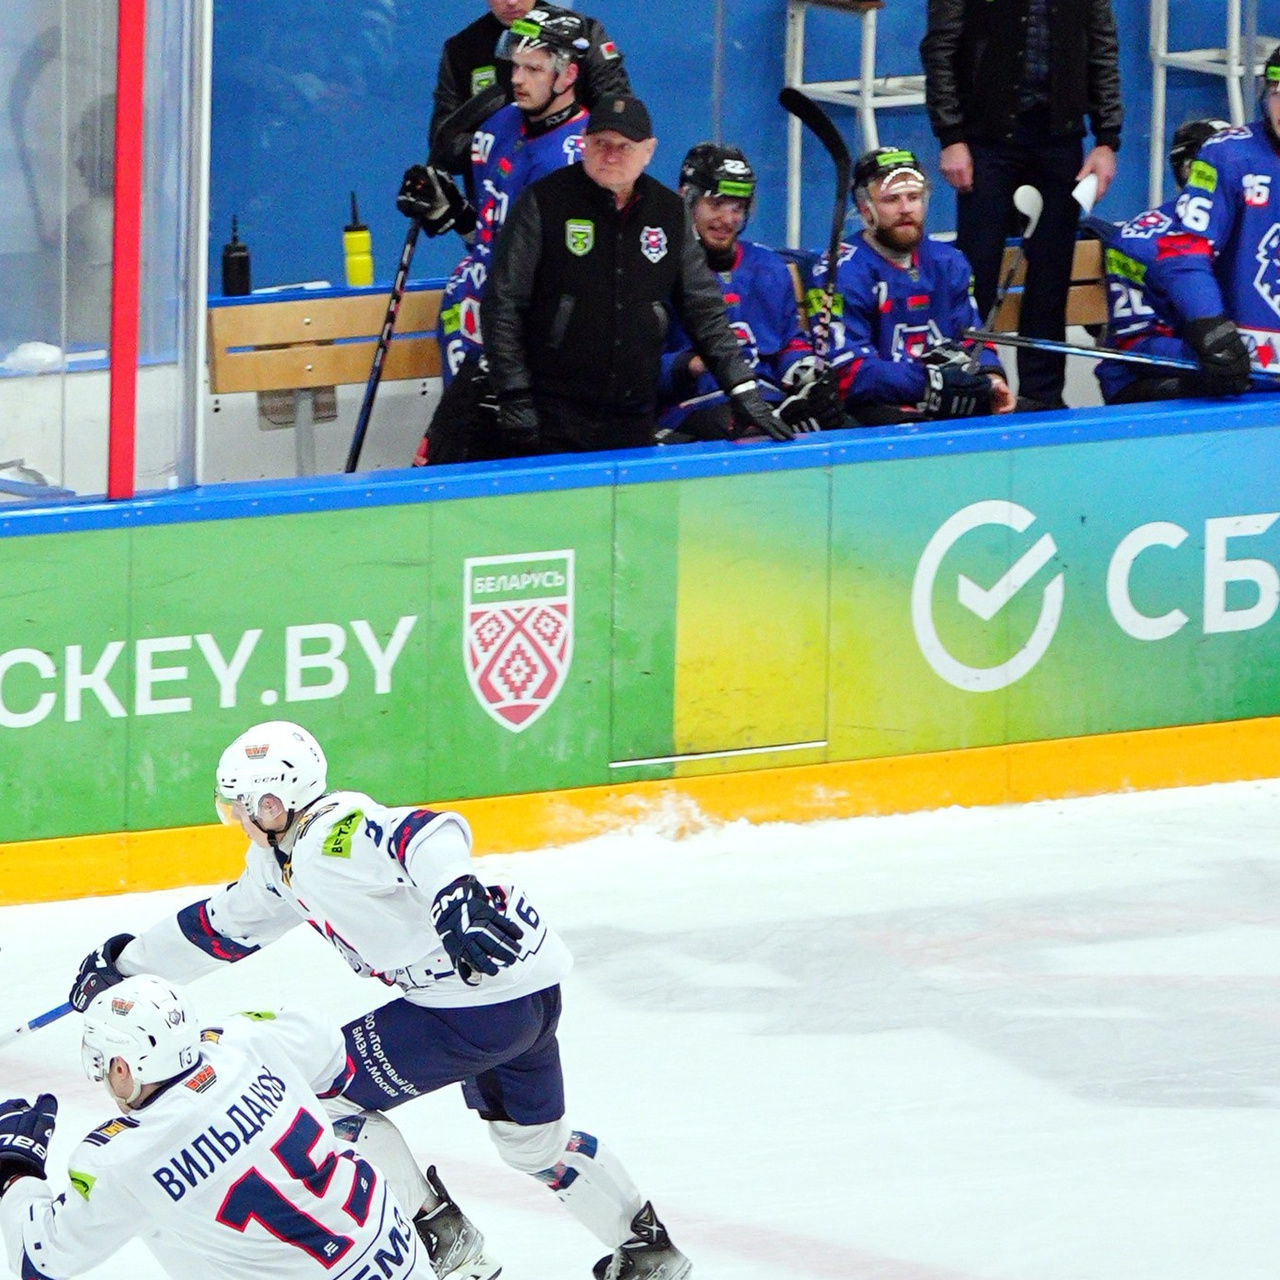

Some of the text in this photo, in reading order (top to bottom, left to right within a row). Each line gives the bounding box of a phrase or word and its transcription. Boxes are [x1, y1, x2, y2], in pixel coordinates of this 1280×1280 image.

[474, 570, 565, 593] БЕЛАРУСЬ
[1106, 513, 1280, 641] СБ
[352, 1026, 368, 1058] БМЗ»
[215, 1106, 377, 1270] 15
